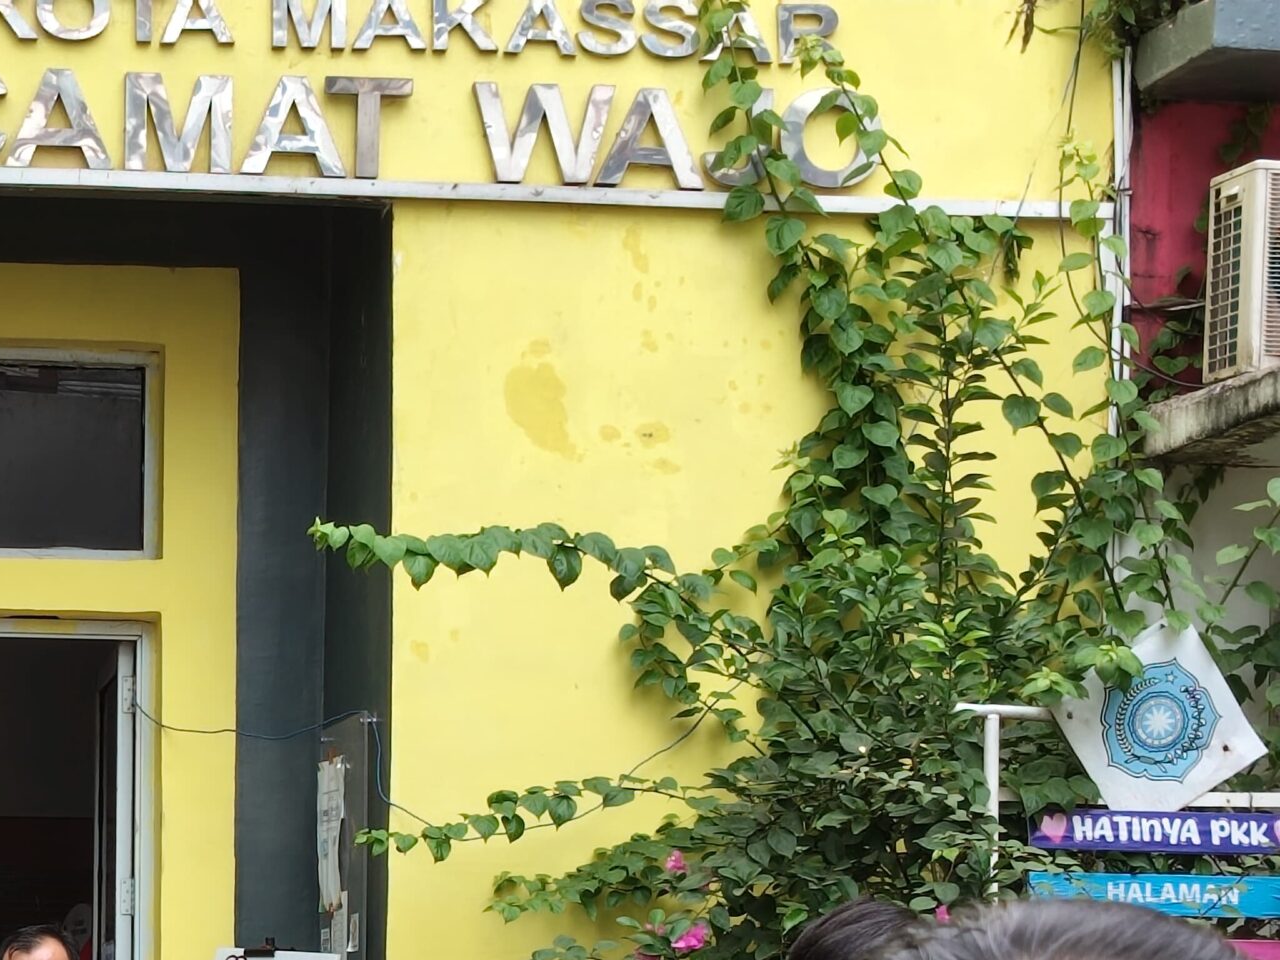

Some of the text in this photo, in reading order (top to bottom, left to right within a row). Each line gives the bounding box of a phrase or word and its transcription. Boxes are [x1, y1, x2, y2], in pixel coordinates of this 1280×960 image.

[272, 0, 843, 66] MAKASSAR
[1211, 819, 1270, 845] PKK
[1107, 881, 1240, 905] HALAMAN
